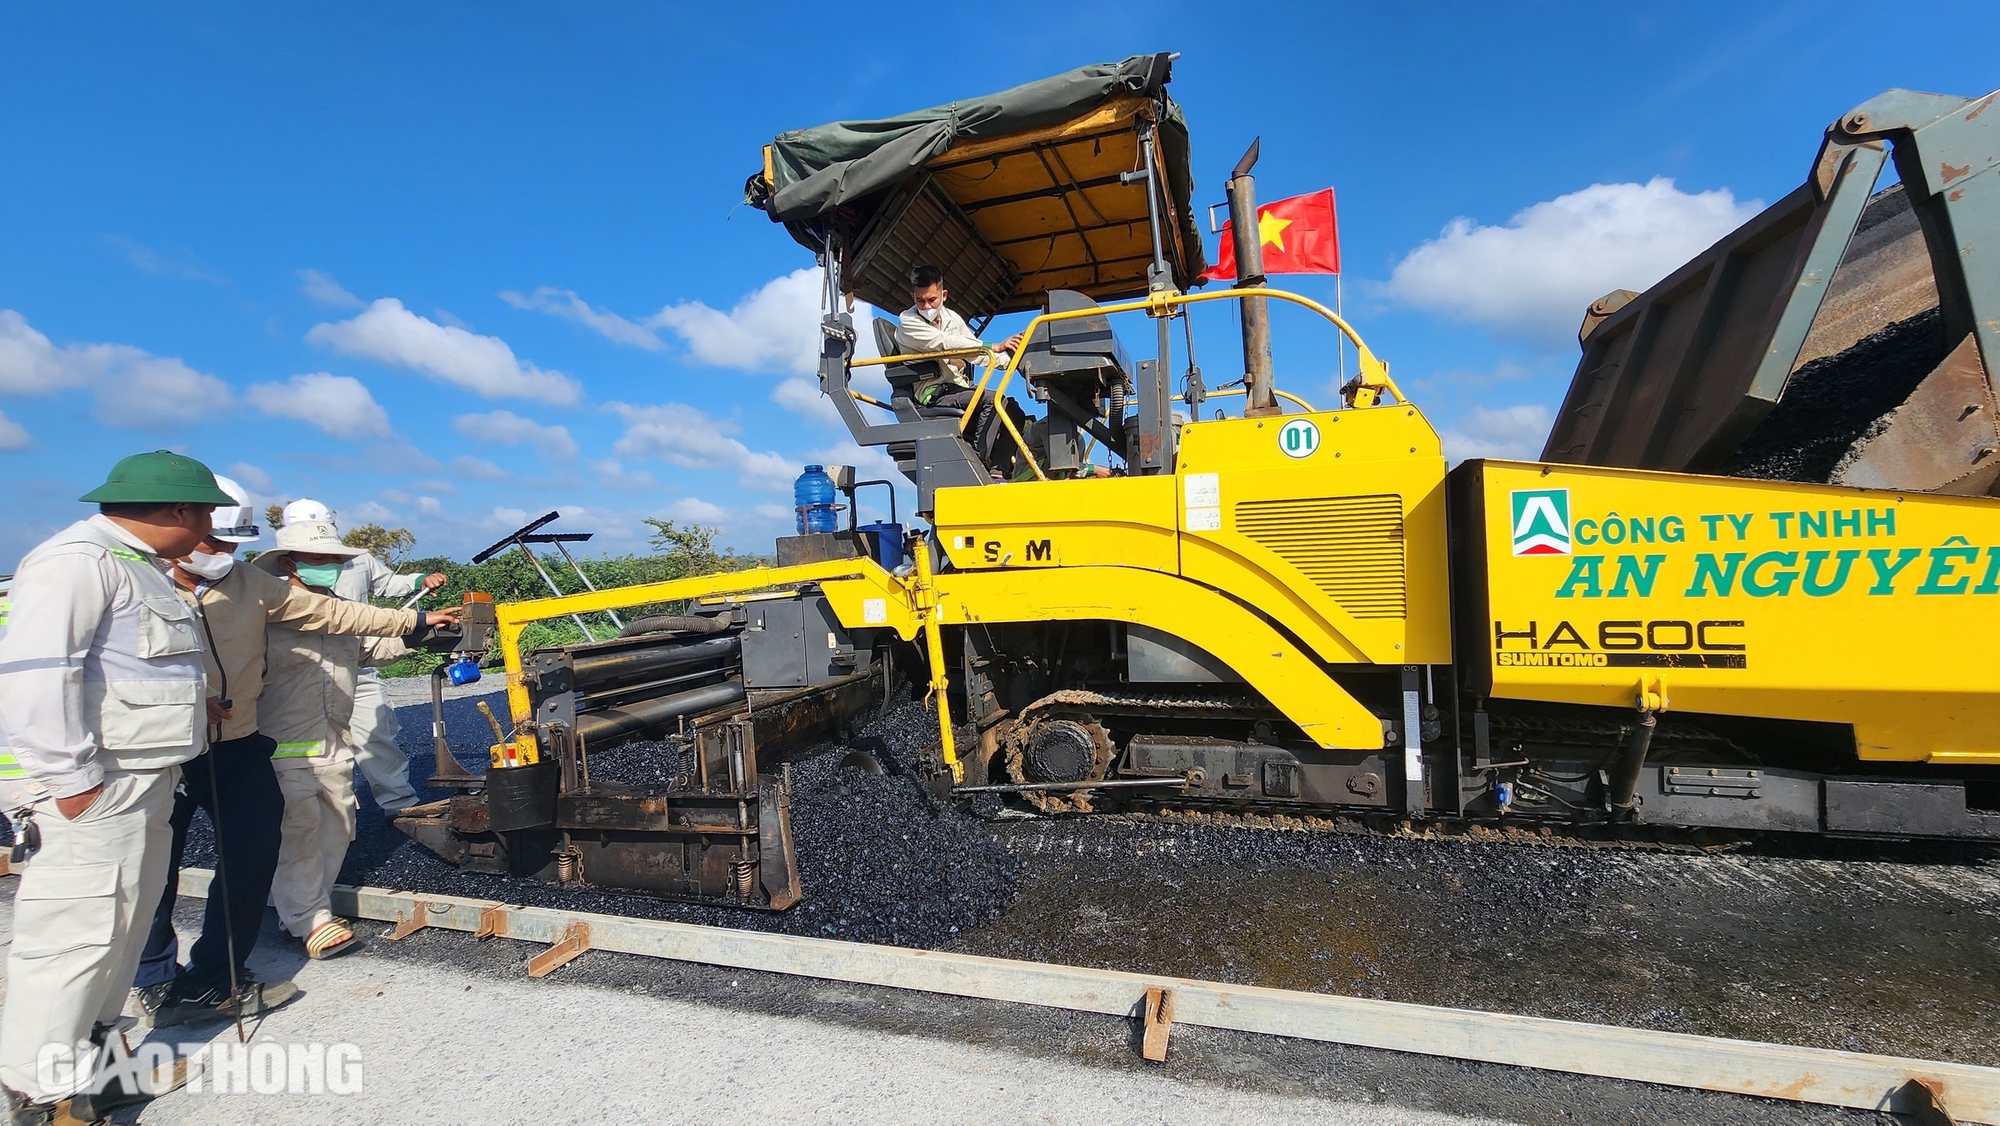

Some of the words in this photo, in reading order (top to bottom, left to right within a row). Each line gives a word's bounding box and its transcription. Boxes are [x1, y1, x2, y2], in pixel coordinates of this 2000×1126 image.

[1286, 427, 1312, 451] 01
[1574, 511, 1686, 546] CÔNG
[1700, 513, 1754, 541] TY
[1769, 508, 1896, 539] TNHH
[1554, 554, 1667, 598] AN
[1494, 620, 1746, 651] HA60C
[1499, 652, 1608, 667] SUMITOMO
